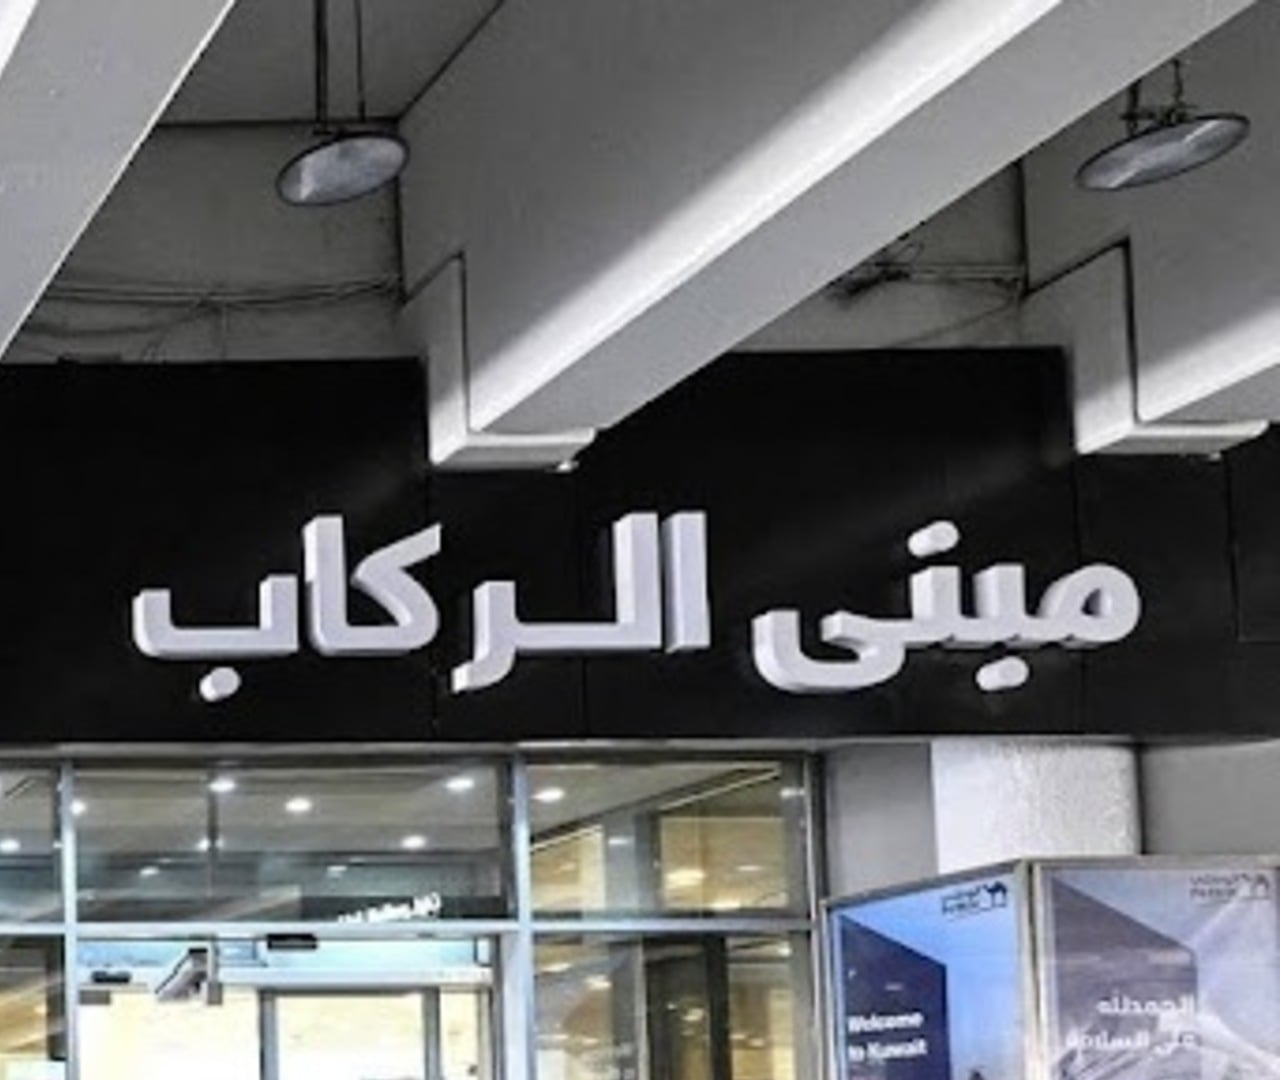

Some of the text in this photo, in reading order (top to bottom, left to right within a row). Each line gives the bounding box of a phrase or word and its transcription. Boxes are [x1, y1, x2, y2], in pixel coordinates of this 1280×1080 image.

[132, 511, 1140, 701] مبنى الركاب
[848, 1011, 924, 1033] Welcome
[848, 1038, 928, 1061] to Kuwait
